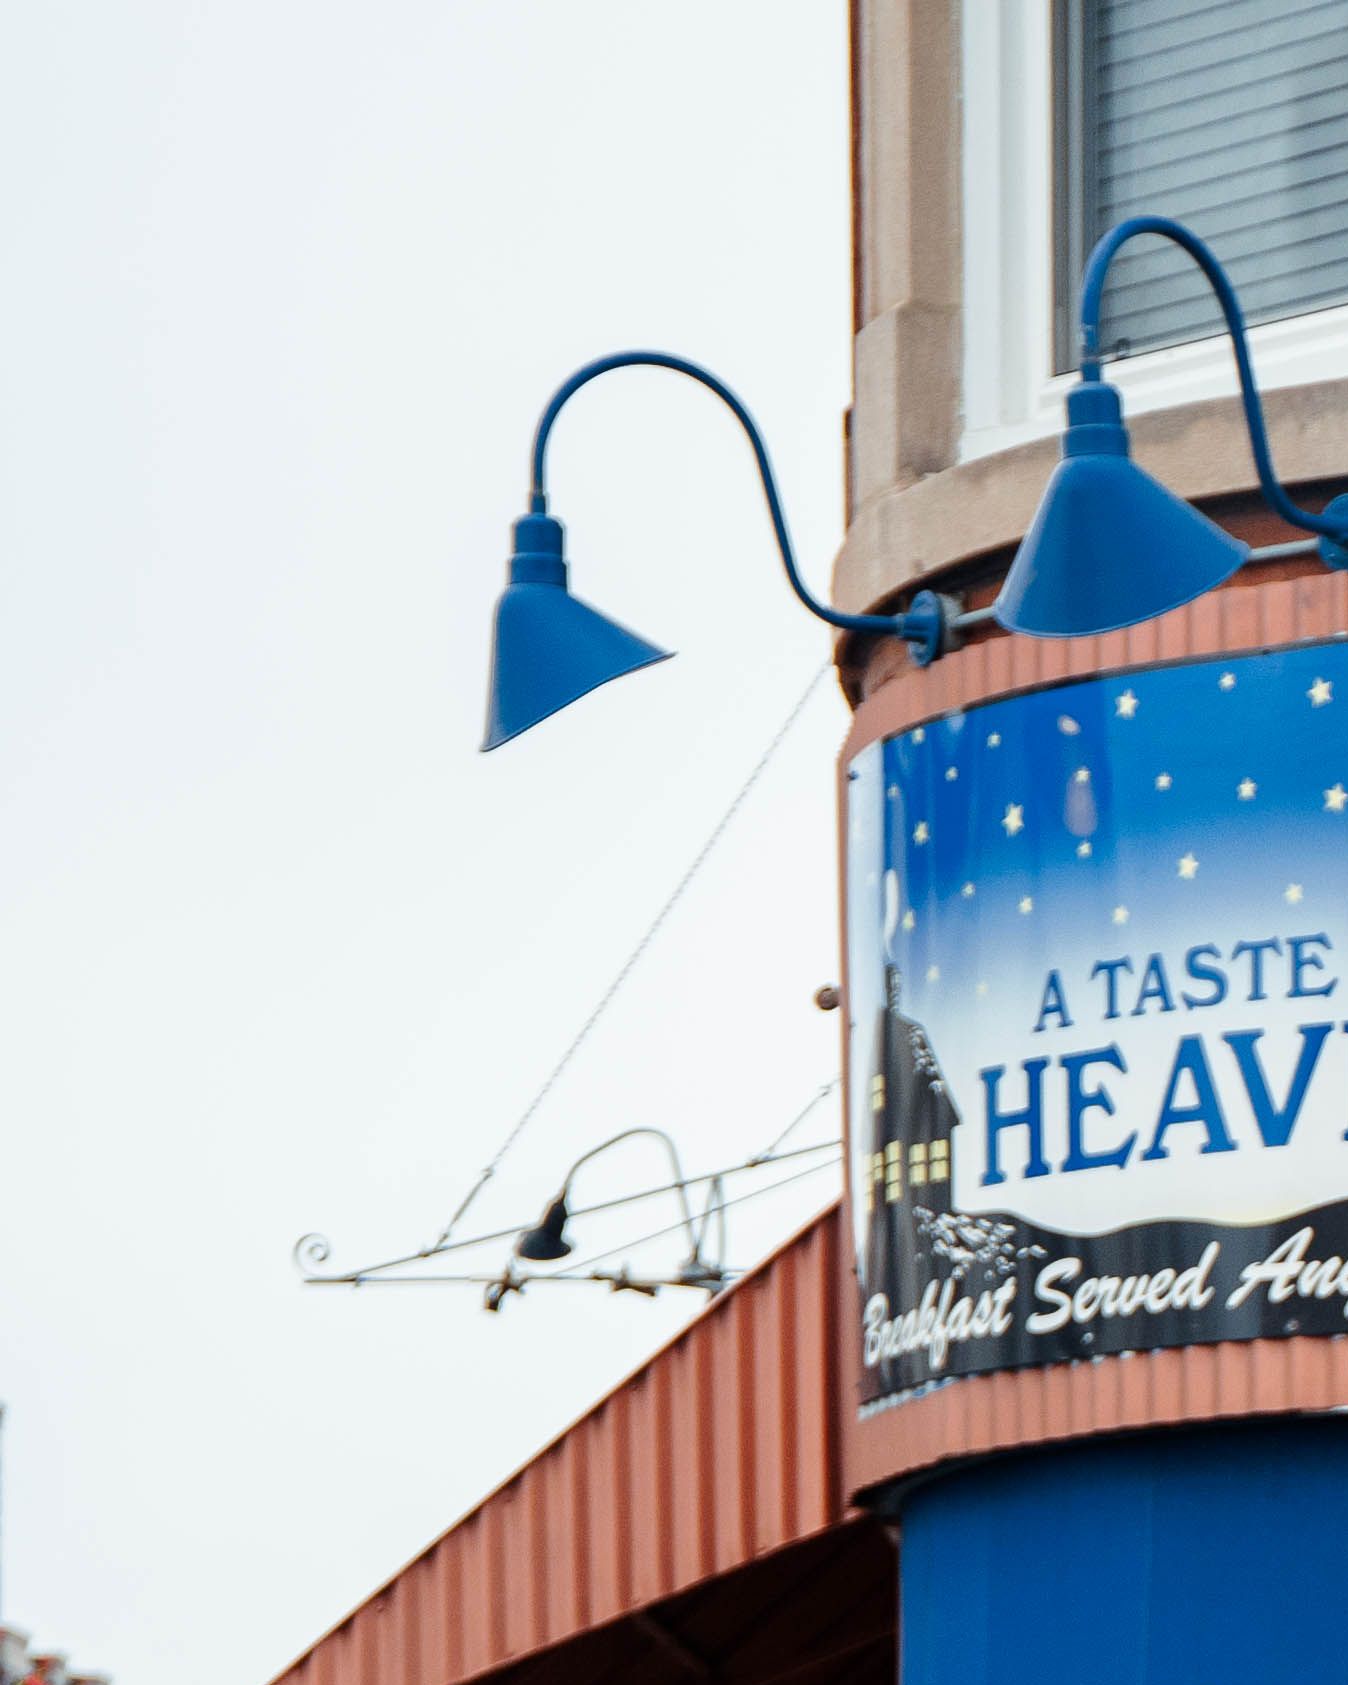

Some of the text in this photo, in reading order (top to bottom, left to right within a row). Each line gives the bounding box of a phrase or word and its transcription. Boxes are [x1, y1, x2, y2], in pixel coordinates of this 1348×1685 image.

[1034, 968, 1074, 1033] A
[1092, 931, 1338, 1020] TASTE
[864, 1277, 1017, 1371] Breakfast
[1025, 1241, 1221, 1335] Served
